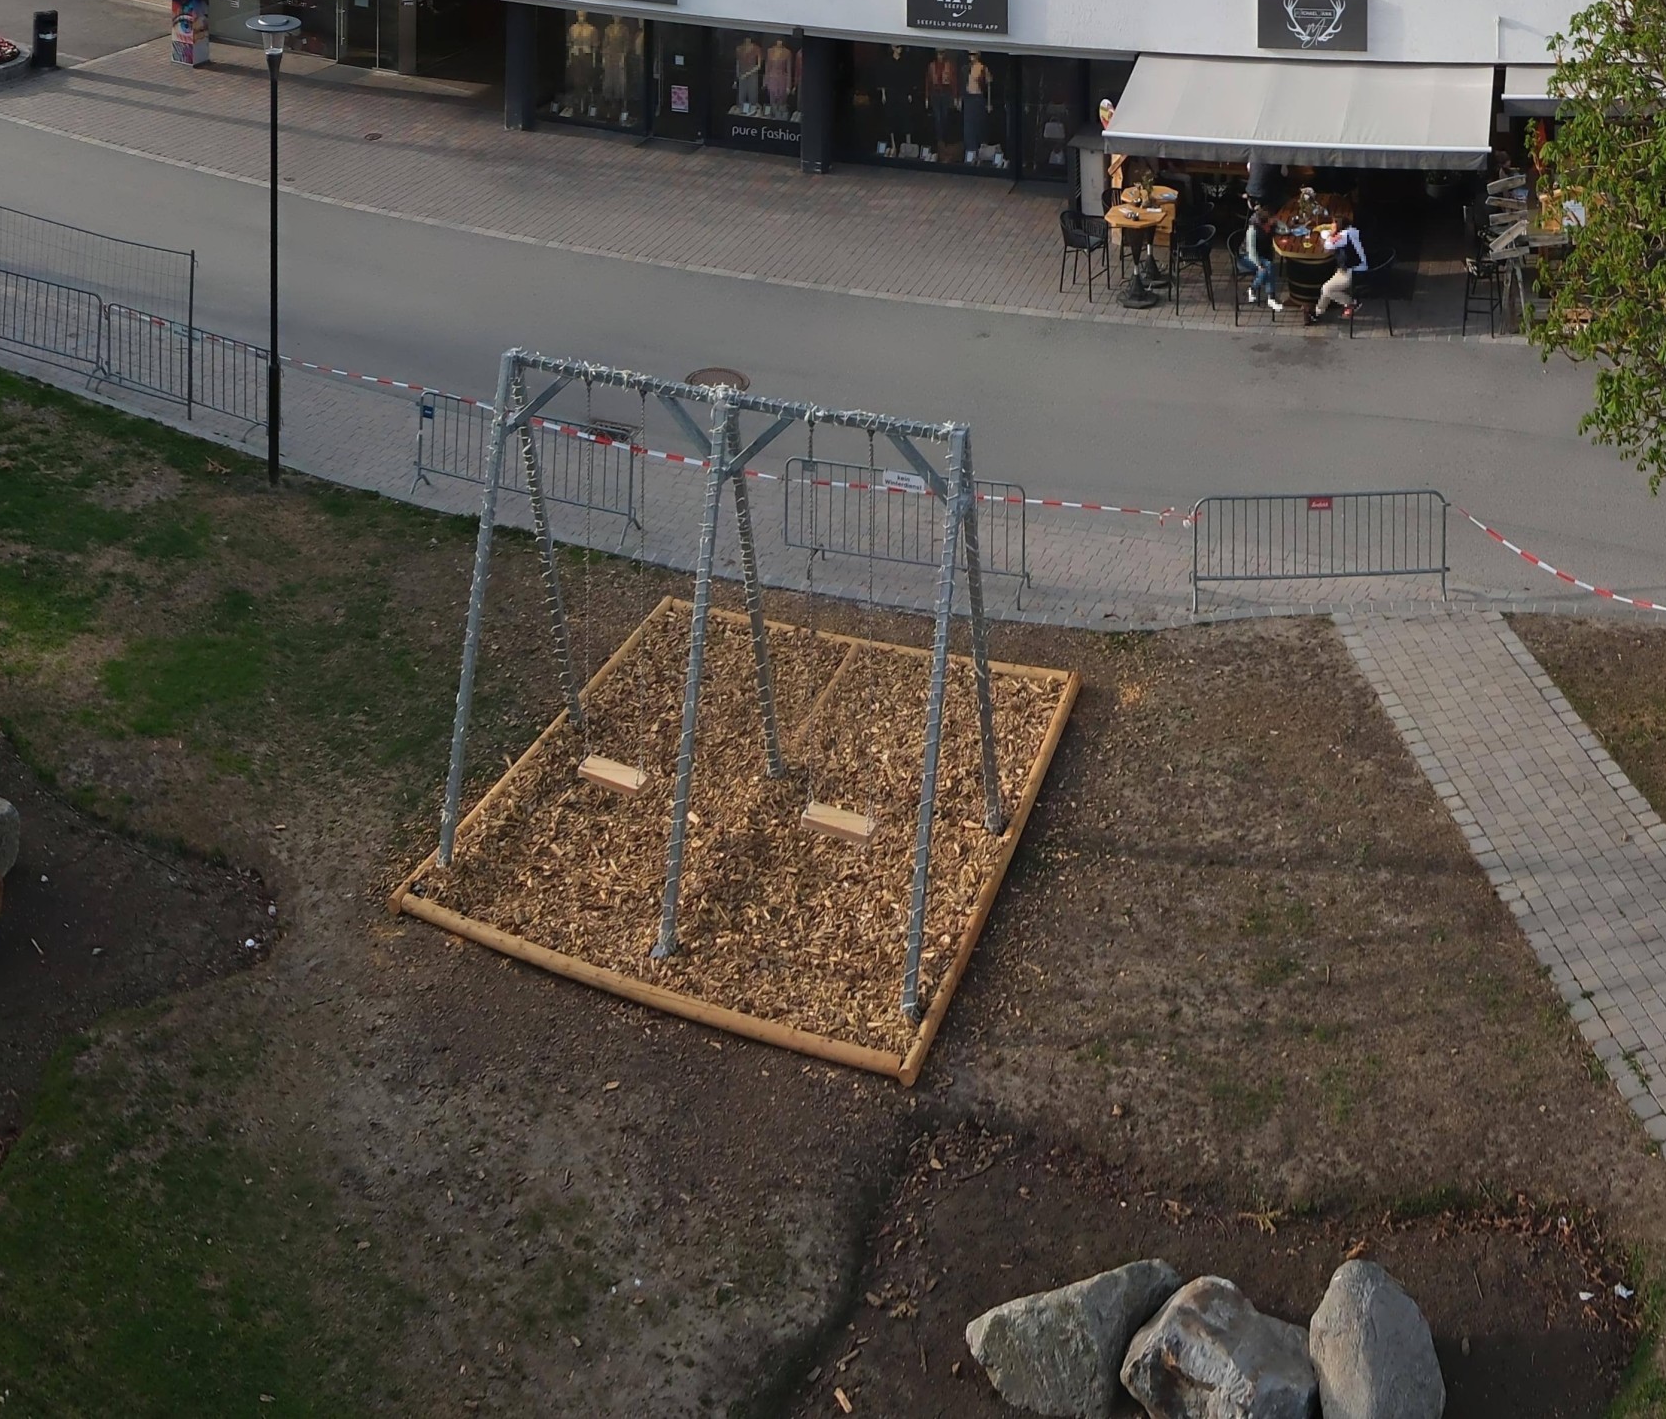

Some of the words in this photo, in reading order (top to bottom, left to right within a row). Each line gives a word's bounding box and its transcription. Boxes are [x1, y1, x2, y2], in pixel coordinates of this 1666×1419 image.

[944, 3, 973, 11] SEEFELD
[732, 126, 757, 137] pure
[897, 474, 910, 482] kein
[885, 479, 923, 491] Winterdienst
